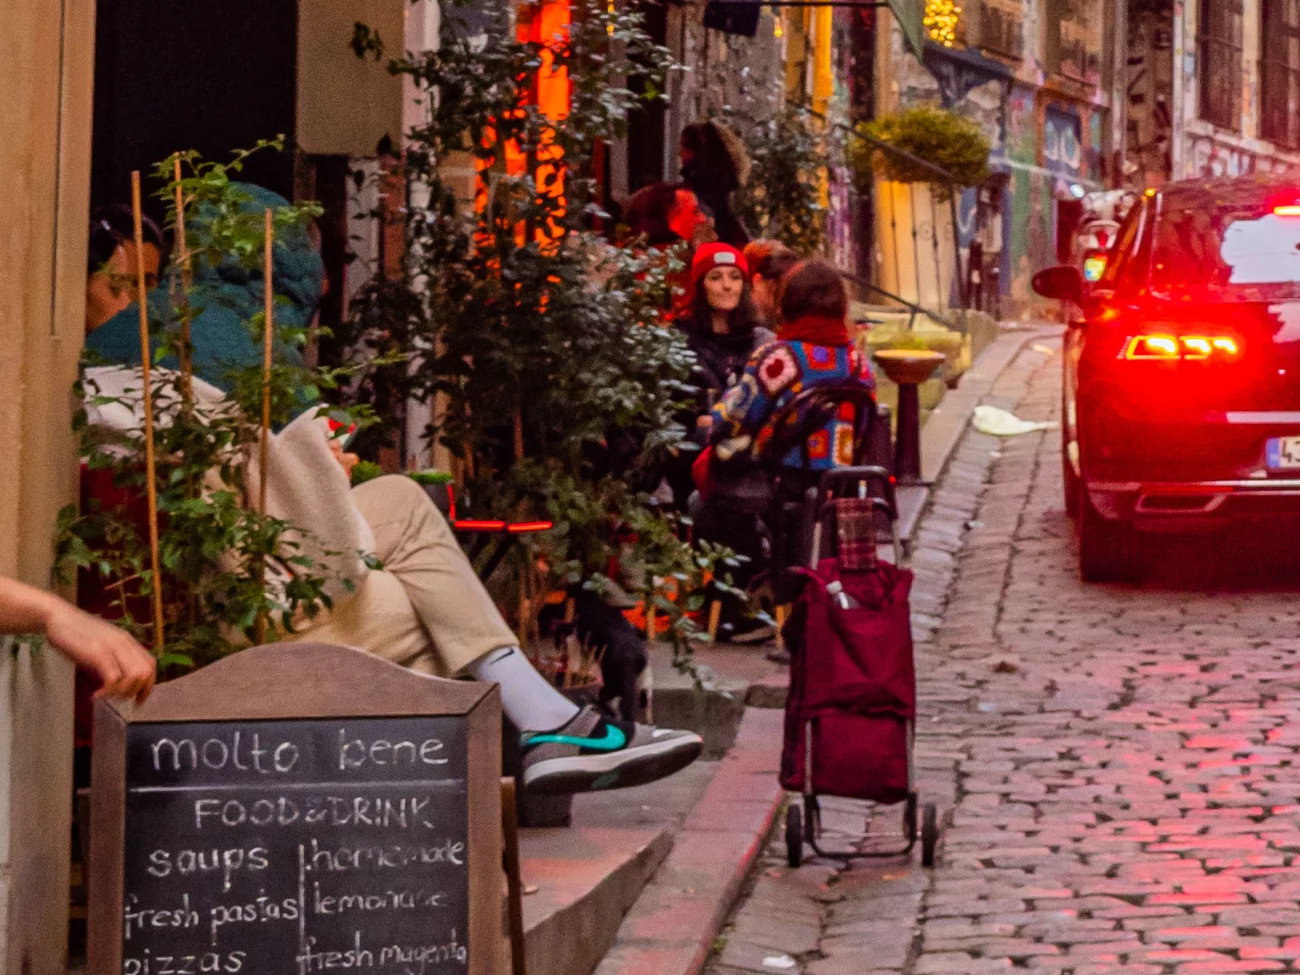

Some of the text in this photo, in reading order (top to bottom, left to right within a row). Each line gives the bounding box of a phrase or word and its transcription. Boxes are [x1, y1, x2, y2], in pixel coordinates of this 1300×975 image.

[151, 729, 448, 773] molto bene
[124, 889, 299, 946] fresh pastas
[296, 931, 373, 972] fresh
